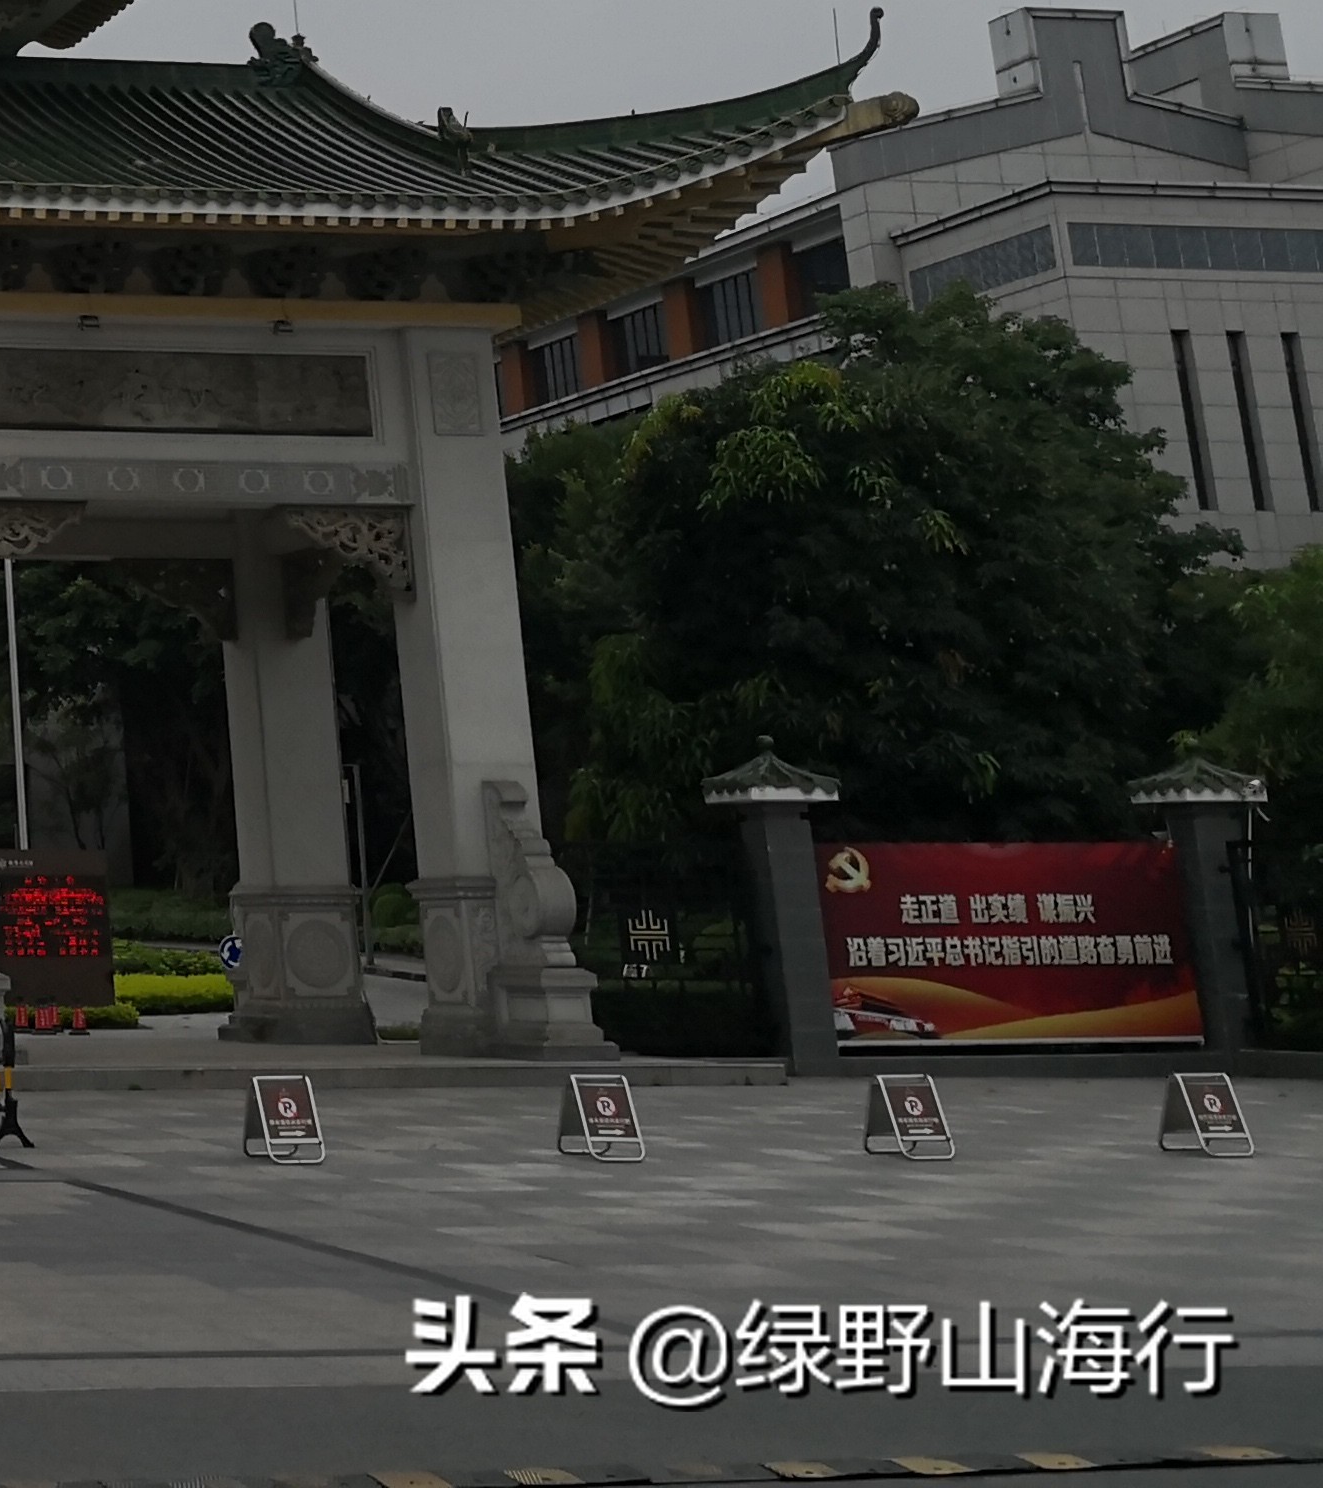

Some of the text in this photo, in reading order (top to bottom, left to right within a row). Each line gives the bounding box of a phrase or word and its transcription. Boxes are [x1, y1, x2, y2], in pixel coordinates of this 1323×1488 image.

[899, 893, 1096, 925] 走正道 出实绩 谋振兴
[846, 934, 1175, 967] 沿着习近平总书记指引的道路奋勇前进
